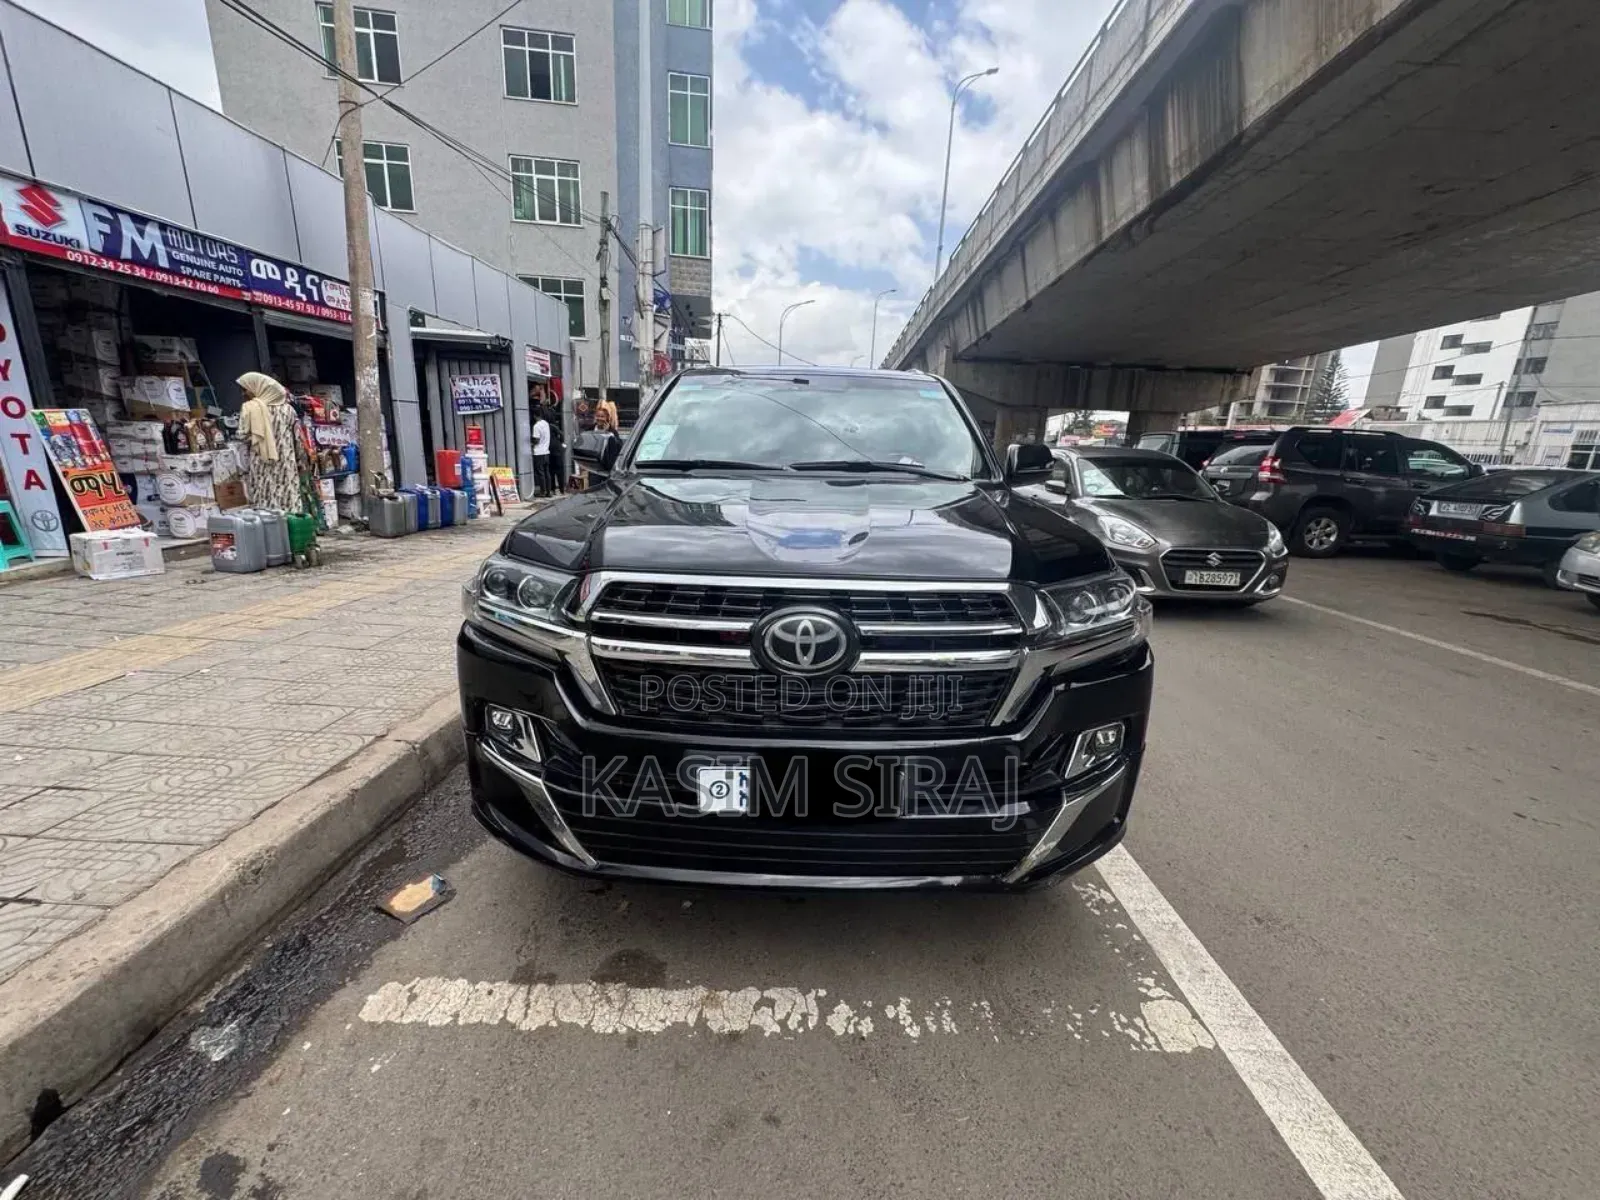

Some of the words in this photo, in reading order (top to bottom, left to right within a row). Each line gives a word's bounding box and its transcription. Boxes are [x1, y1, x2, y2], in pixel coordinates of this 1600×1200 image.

[14, 223, 81, 249] SUZUKI
[80, 200, 169, 269] FM
[167, 226, 238, 264] MOTORS
[172, 250, 217, 270] GENUINE
[218, 263, 244, 277] AUTO
[180, 265, 212, 281] SPARE
[250, 258, 320, 301] መዲና
